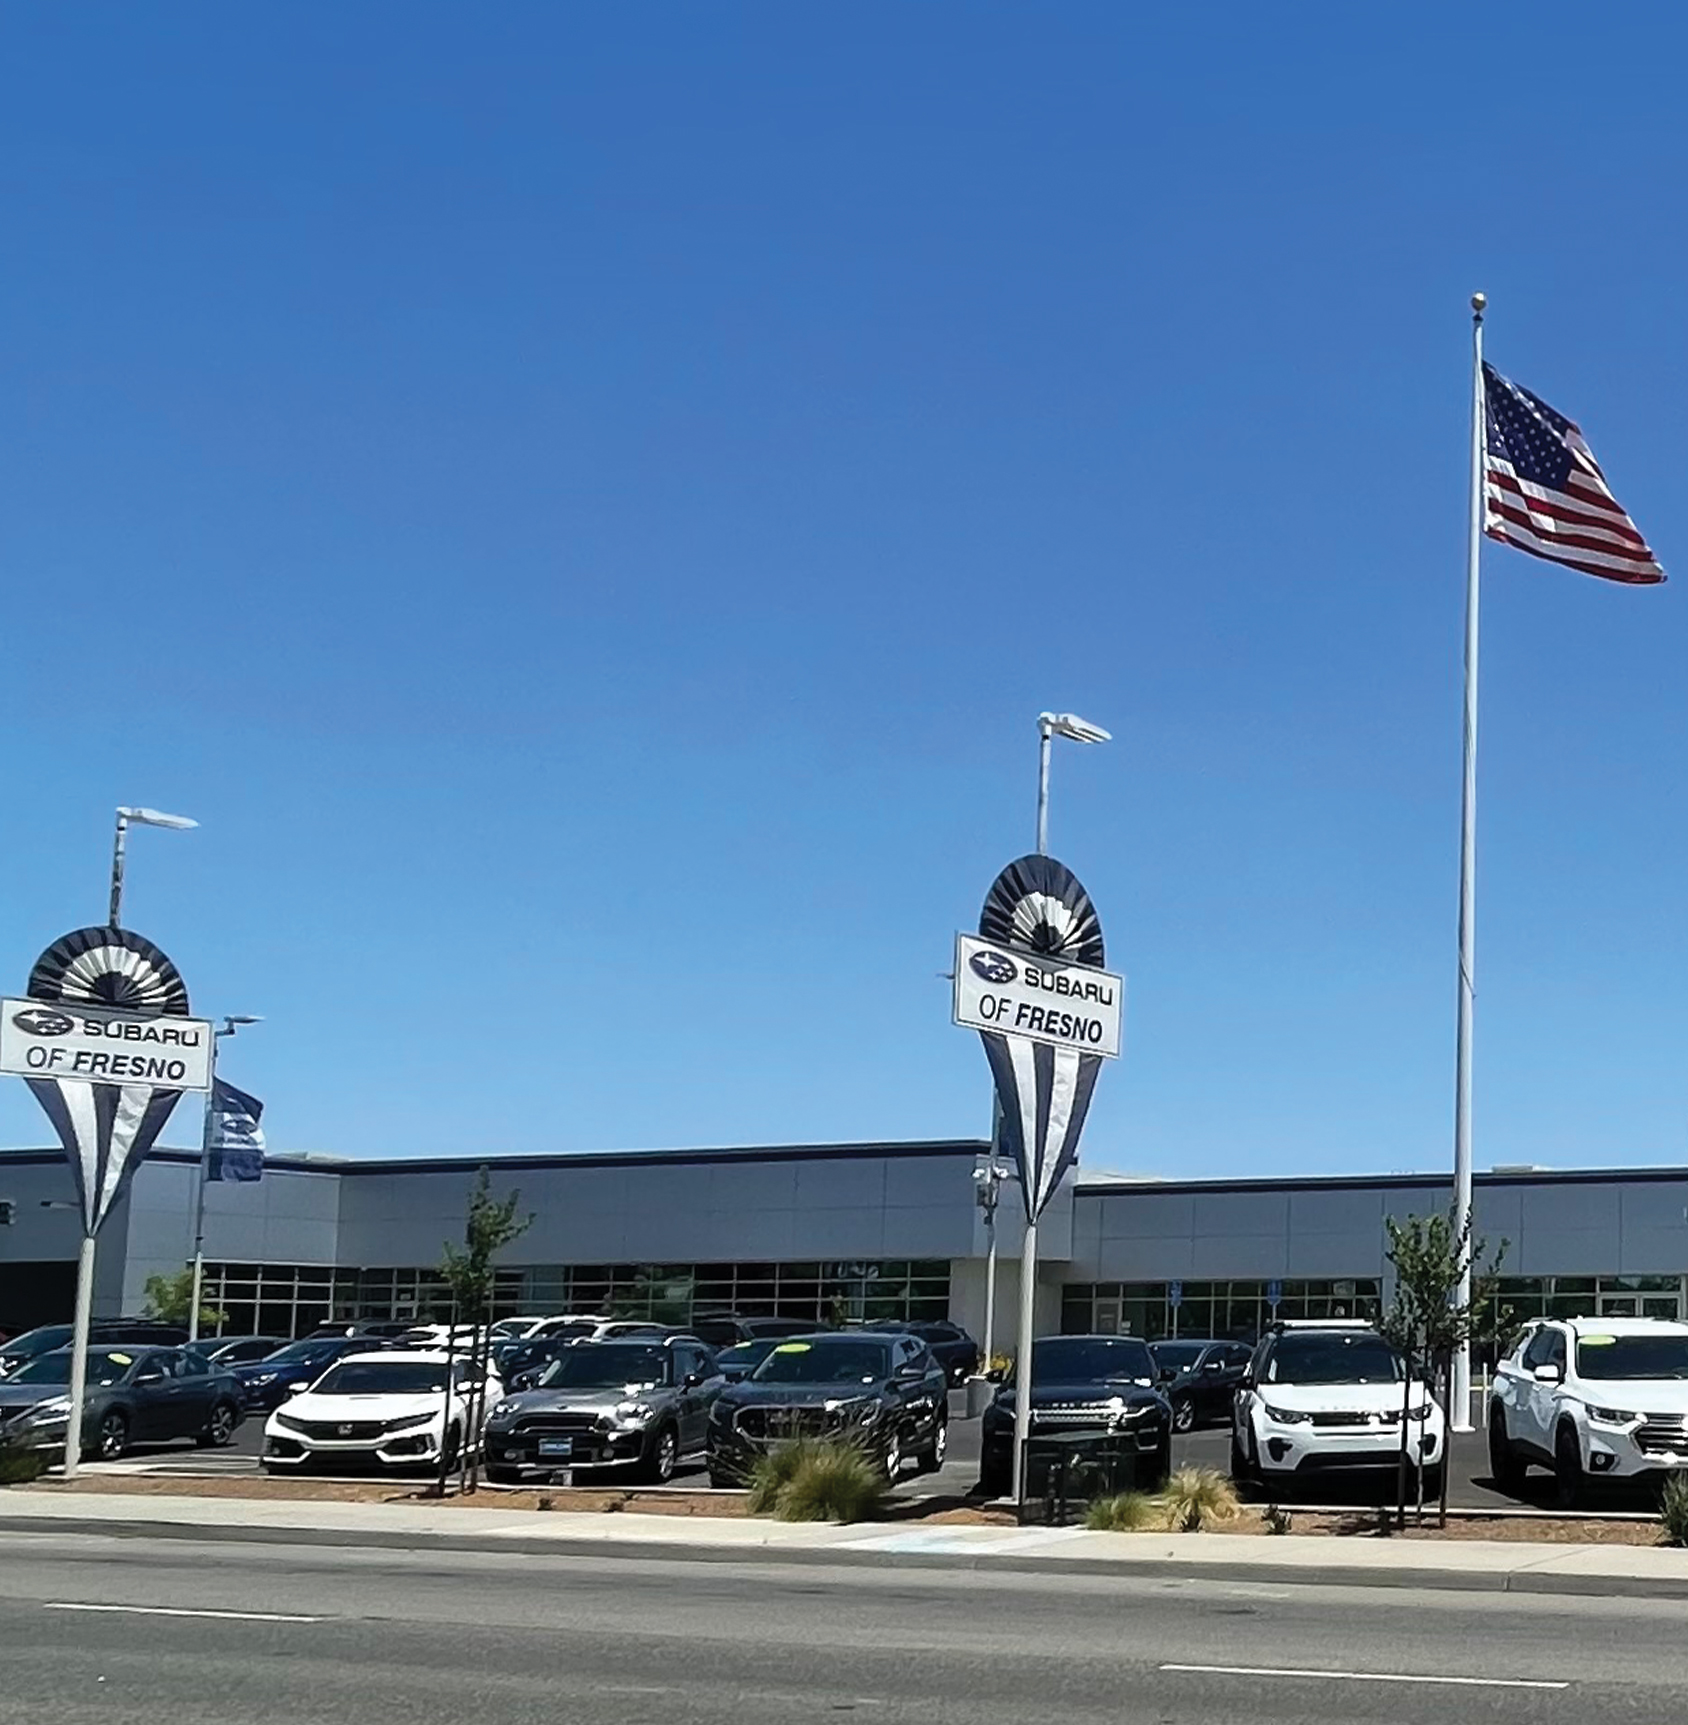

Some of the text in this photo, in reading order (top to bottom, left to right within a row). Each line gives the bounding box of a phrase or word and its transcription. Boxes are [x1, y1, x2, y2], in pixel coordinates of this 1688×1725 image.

[1024, 967, 1113, 1006] SUBARU
[83, 1018, 200, 1047] SUBARU
[979, 994, 1103, 1043] OF FRESNO
[26, 1046, 186, 1081] OF FRESNO
